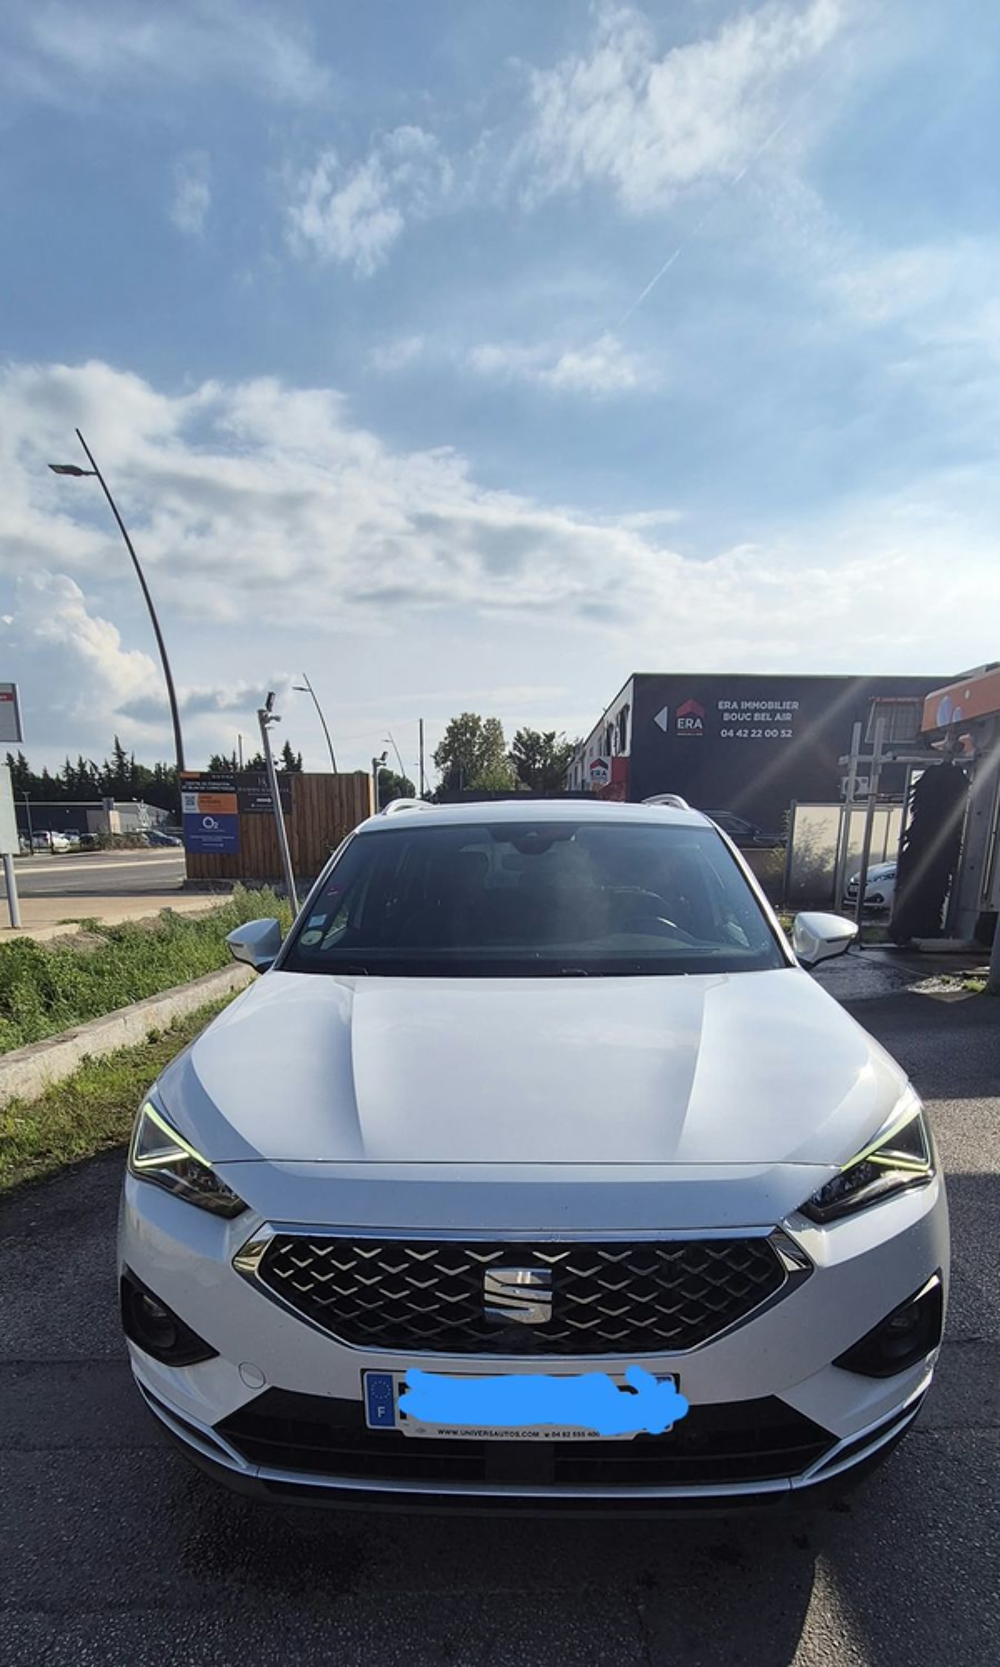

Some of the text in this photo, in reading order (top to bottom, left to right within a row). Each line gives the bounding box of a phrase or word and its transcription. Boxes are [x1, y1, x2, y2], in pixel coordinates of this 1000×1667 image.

[718, 701, 799, 710] ERA IMMOBILIER
[723, 712, 792, 721] BOUC BEL AIR
[677, 718, 702, 729] ERA
[720, 729, 793, 738] 04 42 22 00 52
[378, 1406, 385, 1418] F
